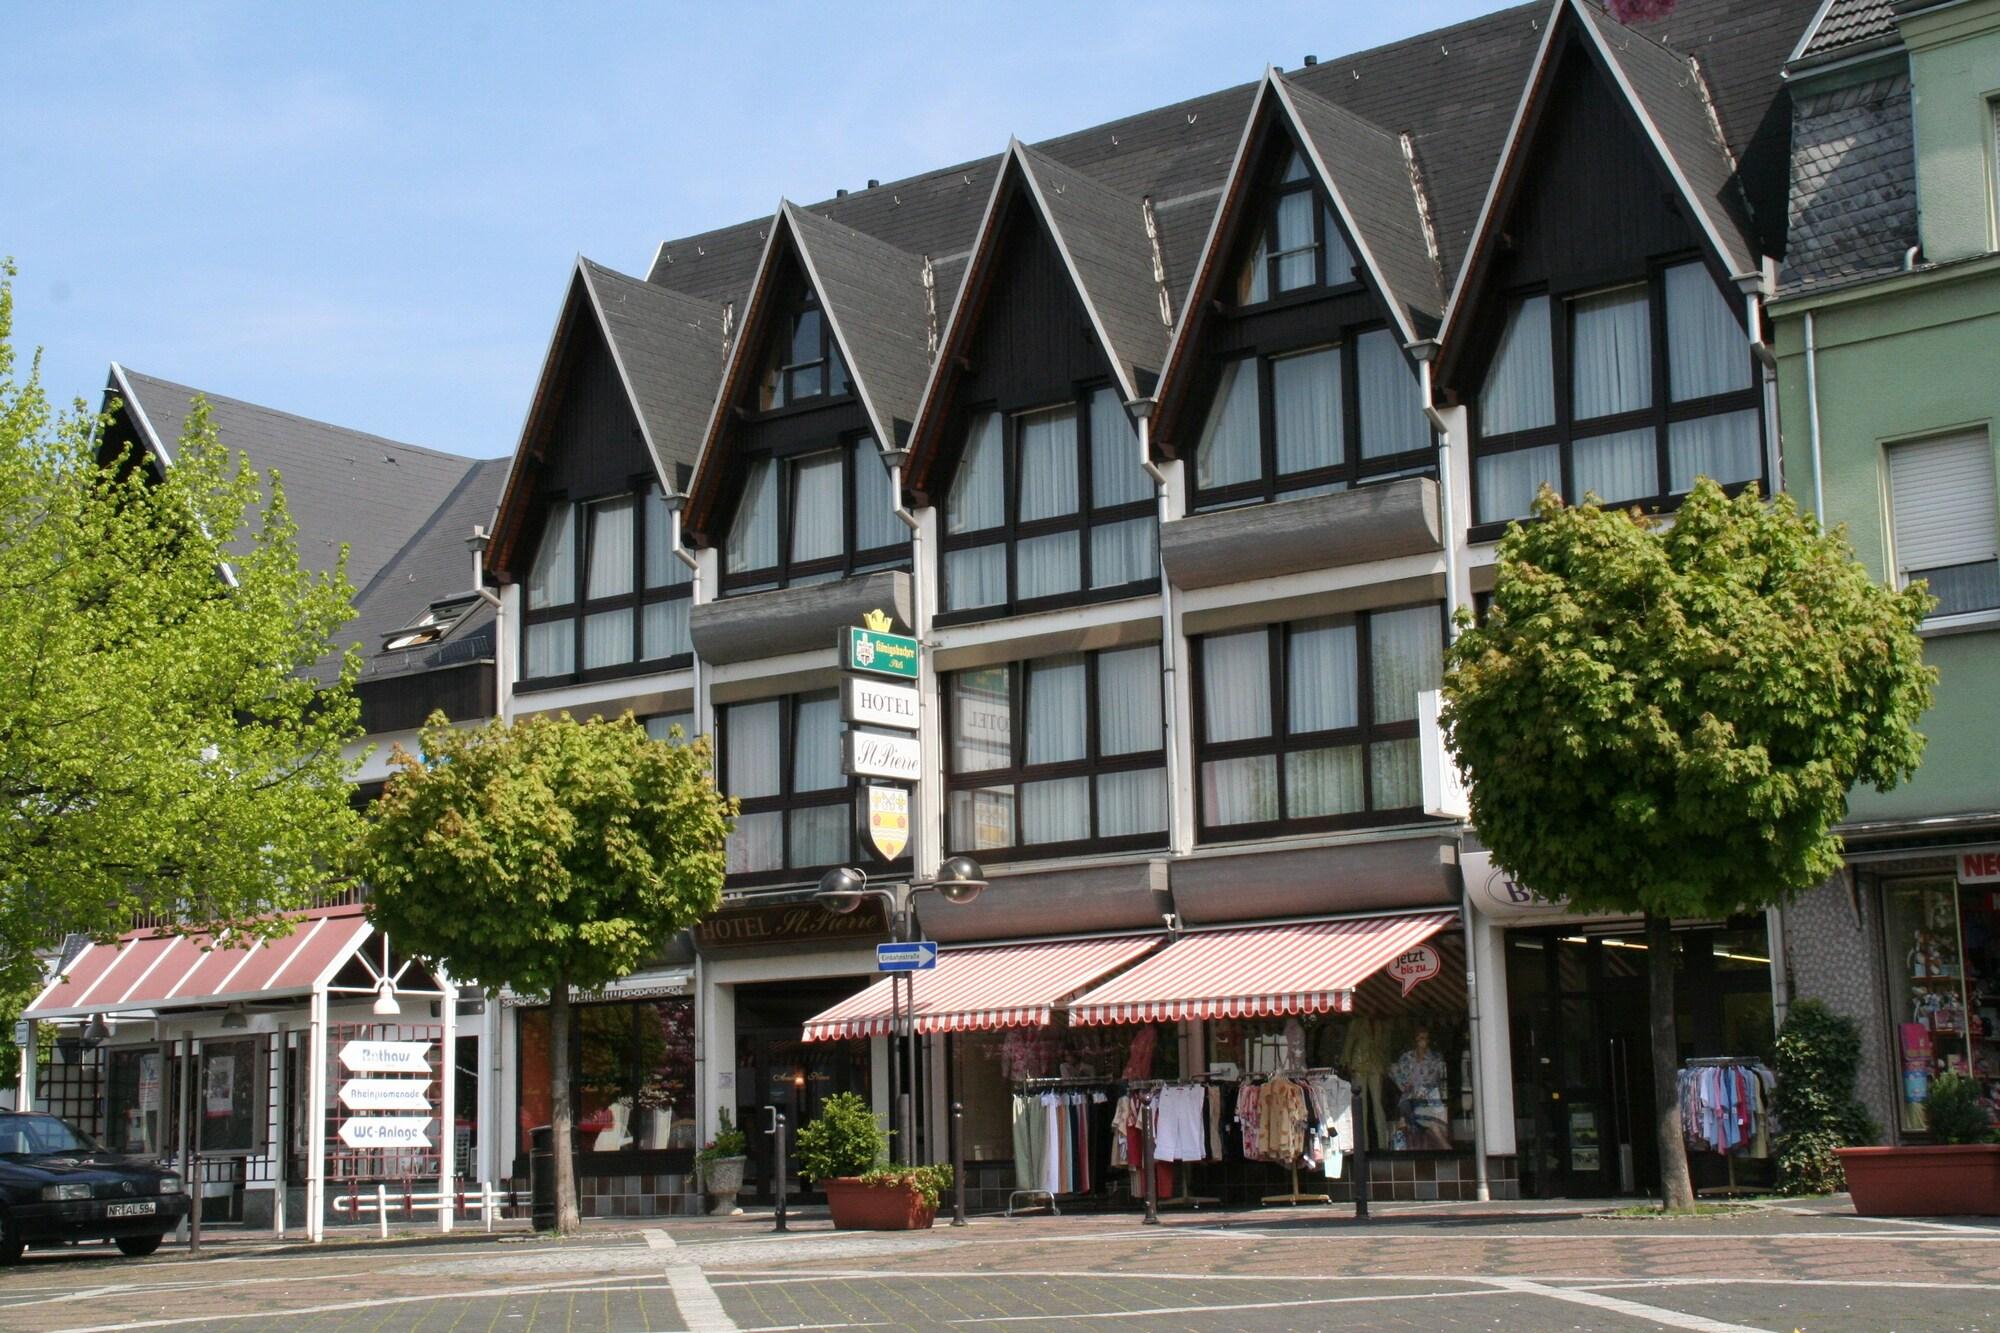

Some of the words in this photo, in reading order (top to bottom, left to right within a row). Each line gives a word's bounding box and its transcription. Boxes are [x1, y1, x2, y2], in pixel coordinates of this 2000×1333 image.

[861, 692, 914, 716] HOTEL
[1963, 853, 2000, 877] NE
[701, 916, 771, 940] HOTEL
[1401, 964, 1414, 975] bis
[354, 1125, 418, 1141] WC-Anlage
